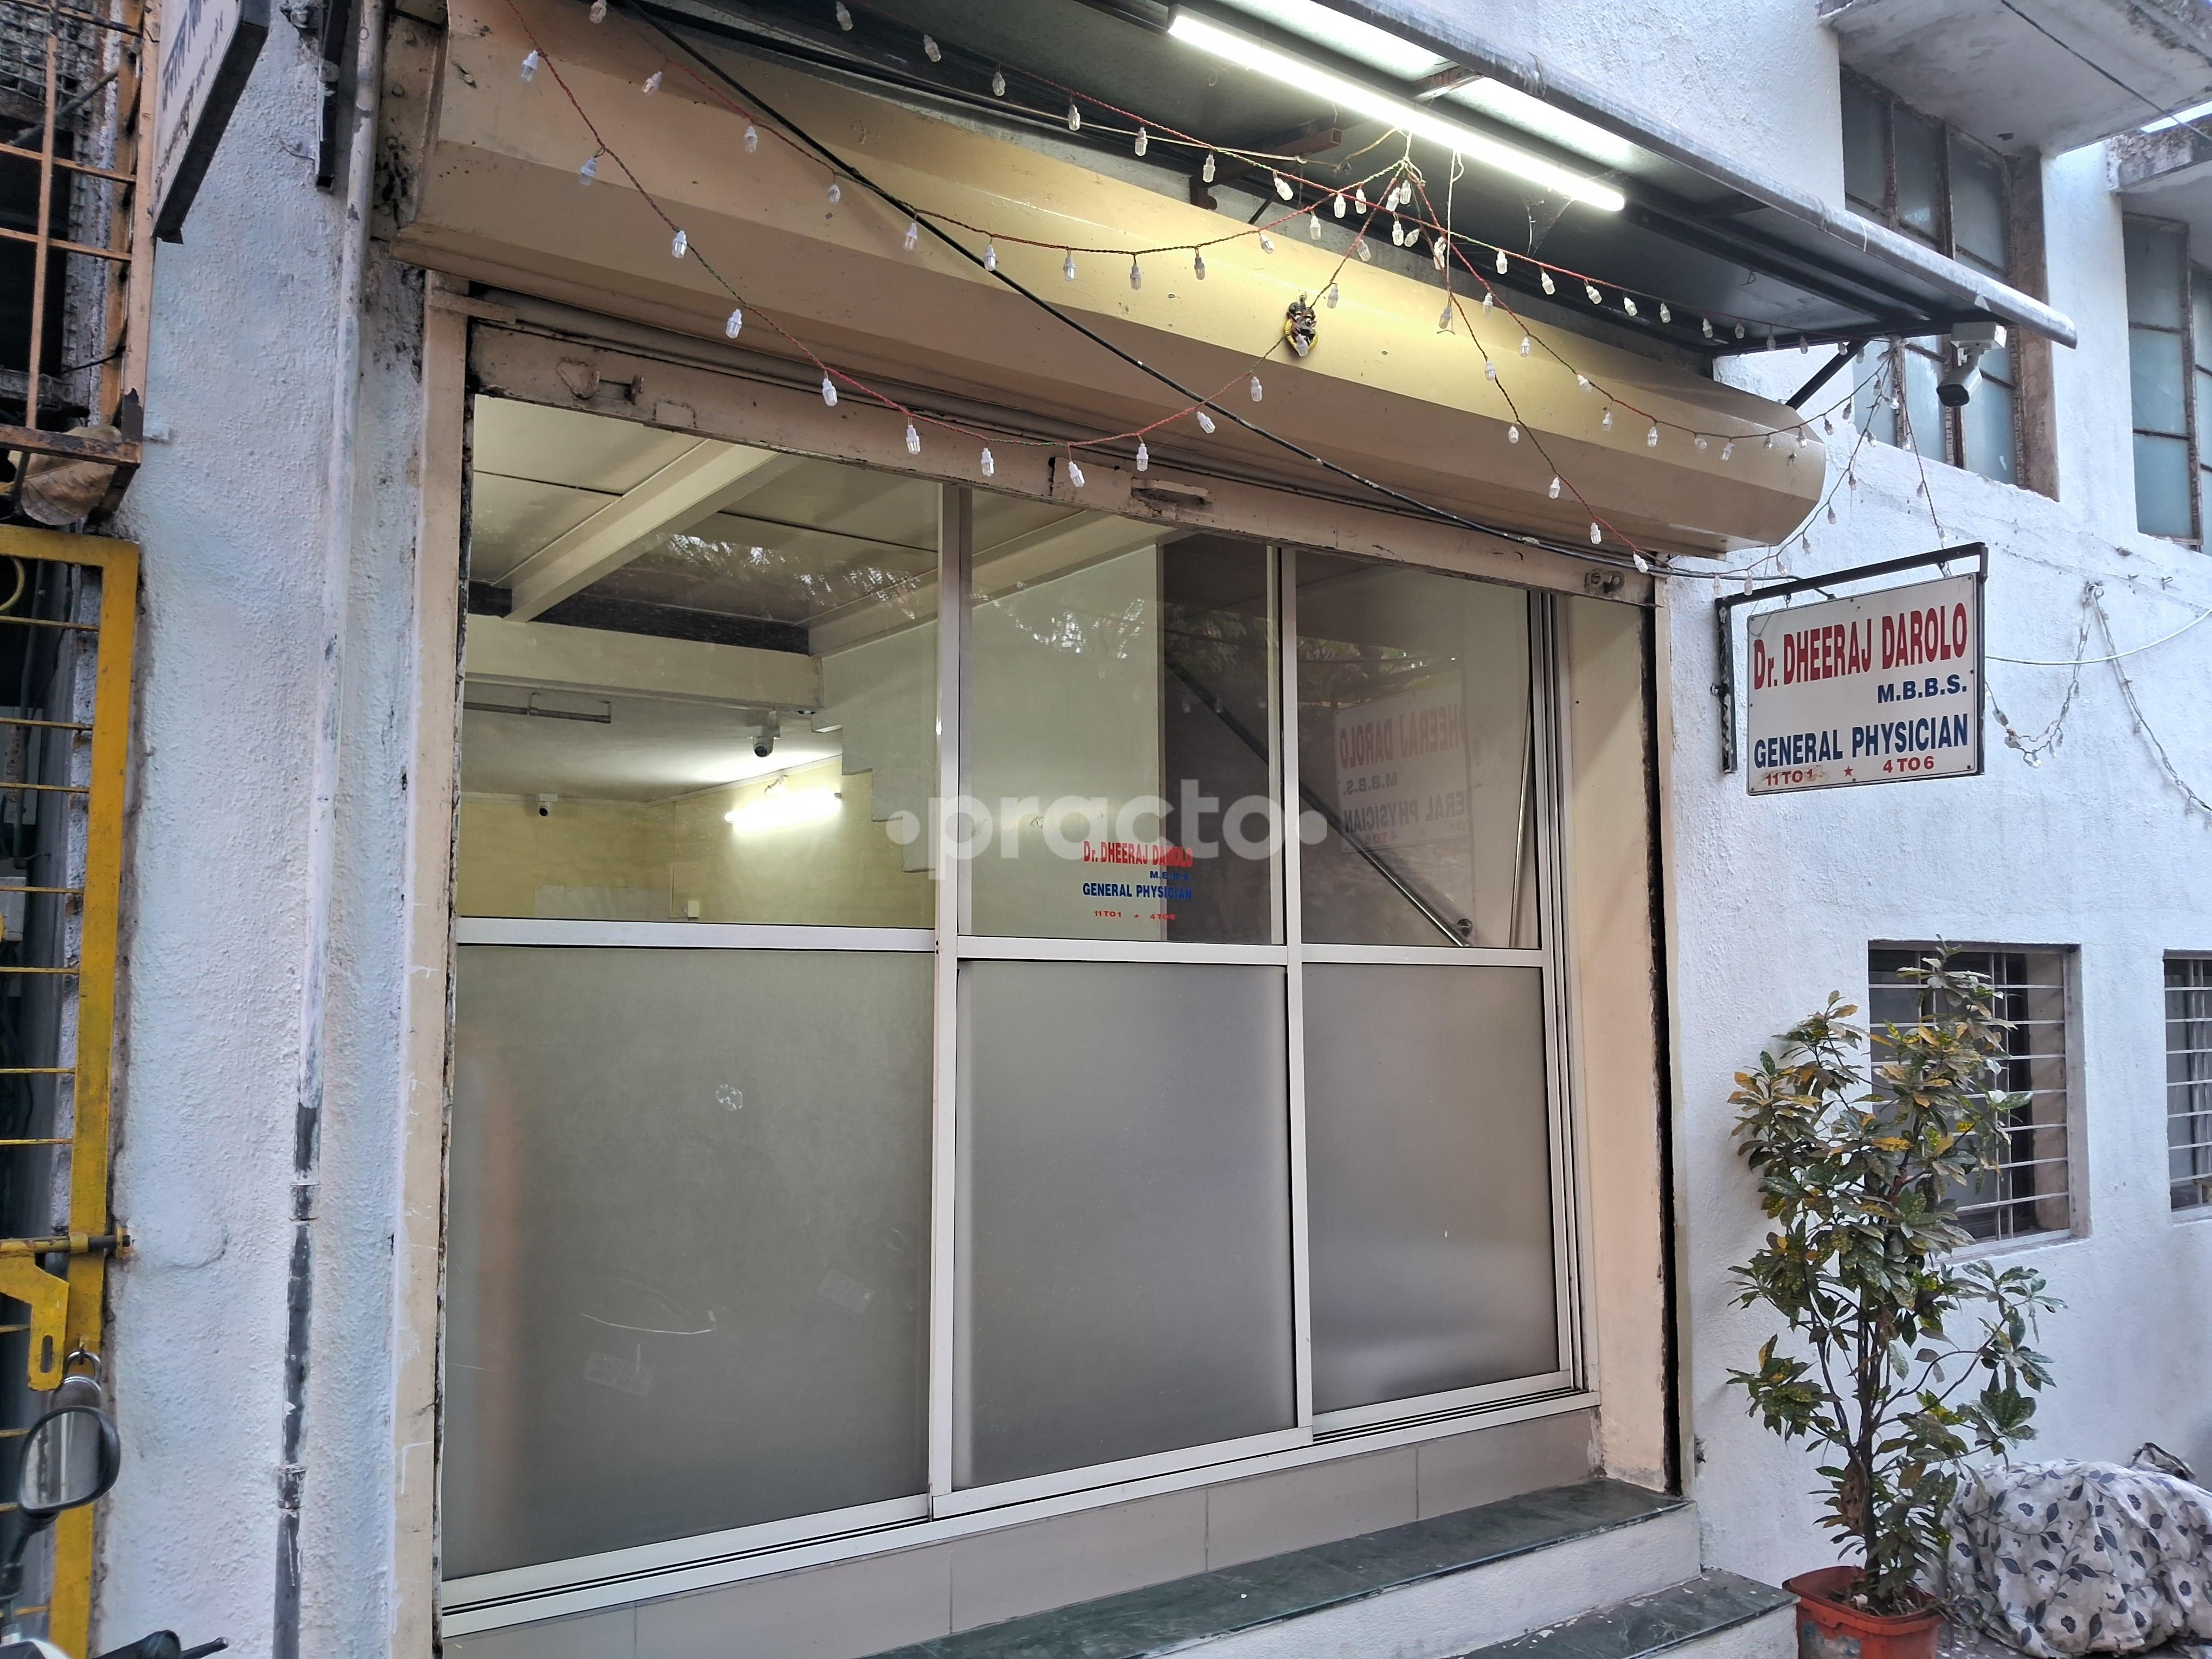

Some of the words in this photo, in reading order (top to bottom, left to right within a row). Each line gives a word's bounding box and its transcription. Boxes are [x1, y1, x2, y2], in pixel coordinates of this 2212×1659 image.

[1754, 639, 1778, 690] Dr.
[1784, 619, 1872, 685] DHEERAJ
[1882, 603, 1967, 669] DAROLO
[1877, 674, 1967, 703] M.B.B.S.
[1754, 730, 1843, 768] GENERAL
[1852, 713, 1967, 757] PHYSICIAN
[1084, 841, 1098, 862] Dr.
[1101, 842, 1148, 865] DHEERAJ
[1083, 883, 1132, 897] GENERAL
[1136, 885, 1192, 899] PHYSICIAN
